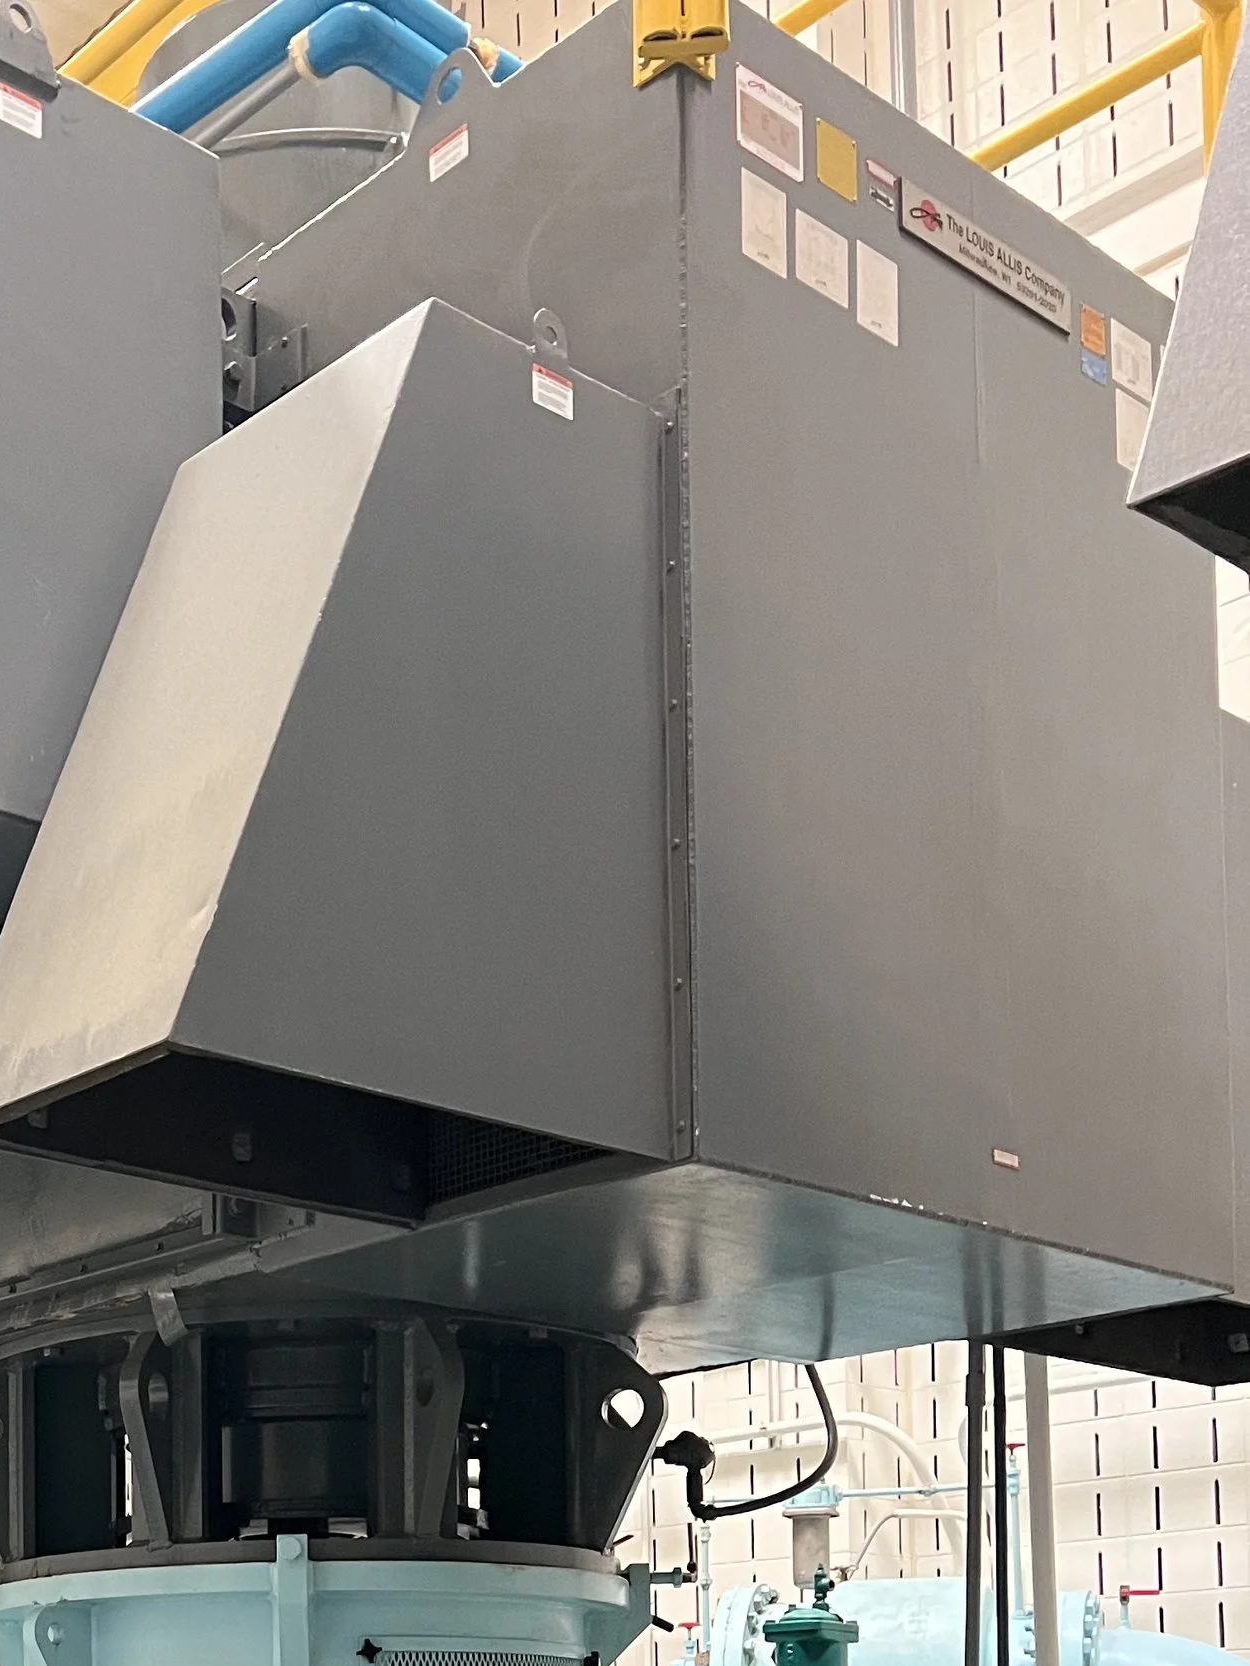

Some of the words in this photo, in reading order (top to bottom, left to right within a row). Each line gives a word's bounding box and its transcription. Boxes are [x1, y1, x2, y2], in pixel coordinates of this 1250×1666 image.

[947, 213, 964, 238] The
[966, 225, 995, 258] LOUIS
[996, 248, 1023, 276] ALLIS
[1025, 266, 1066, 307] Company
